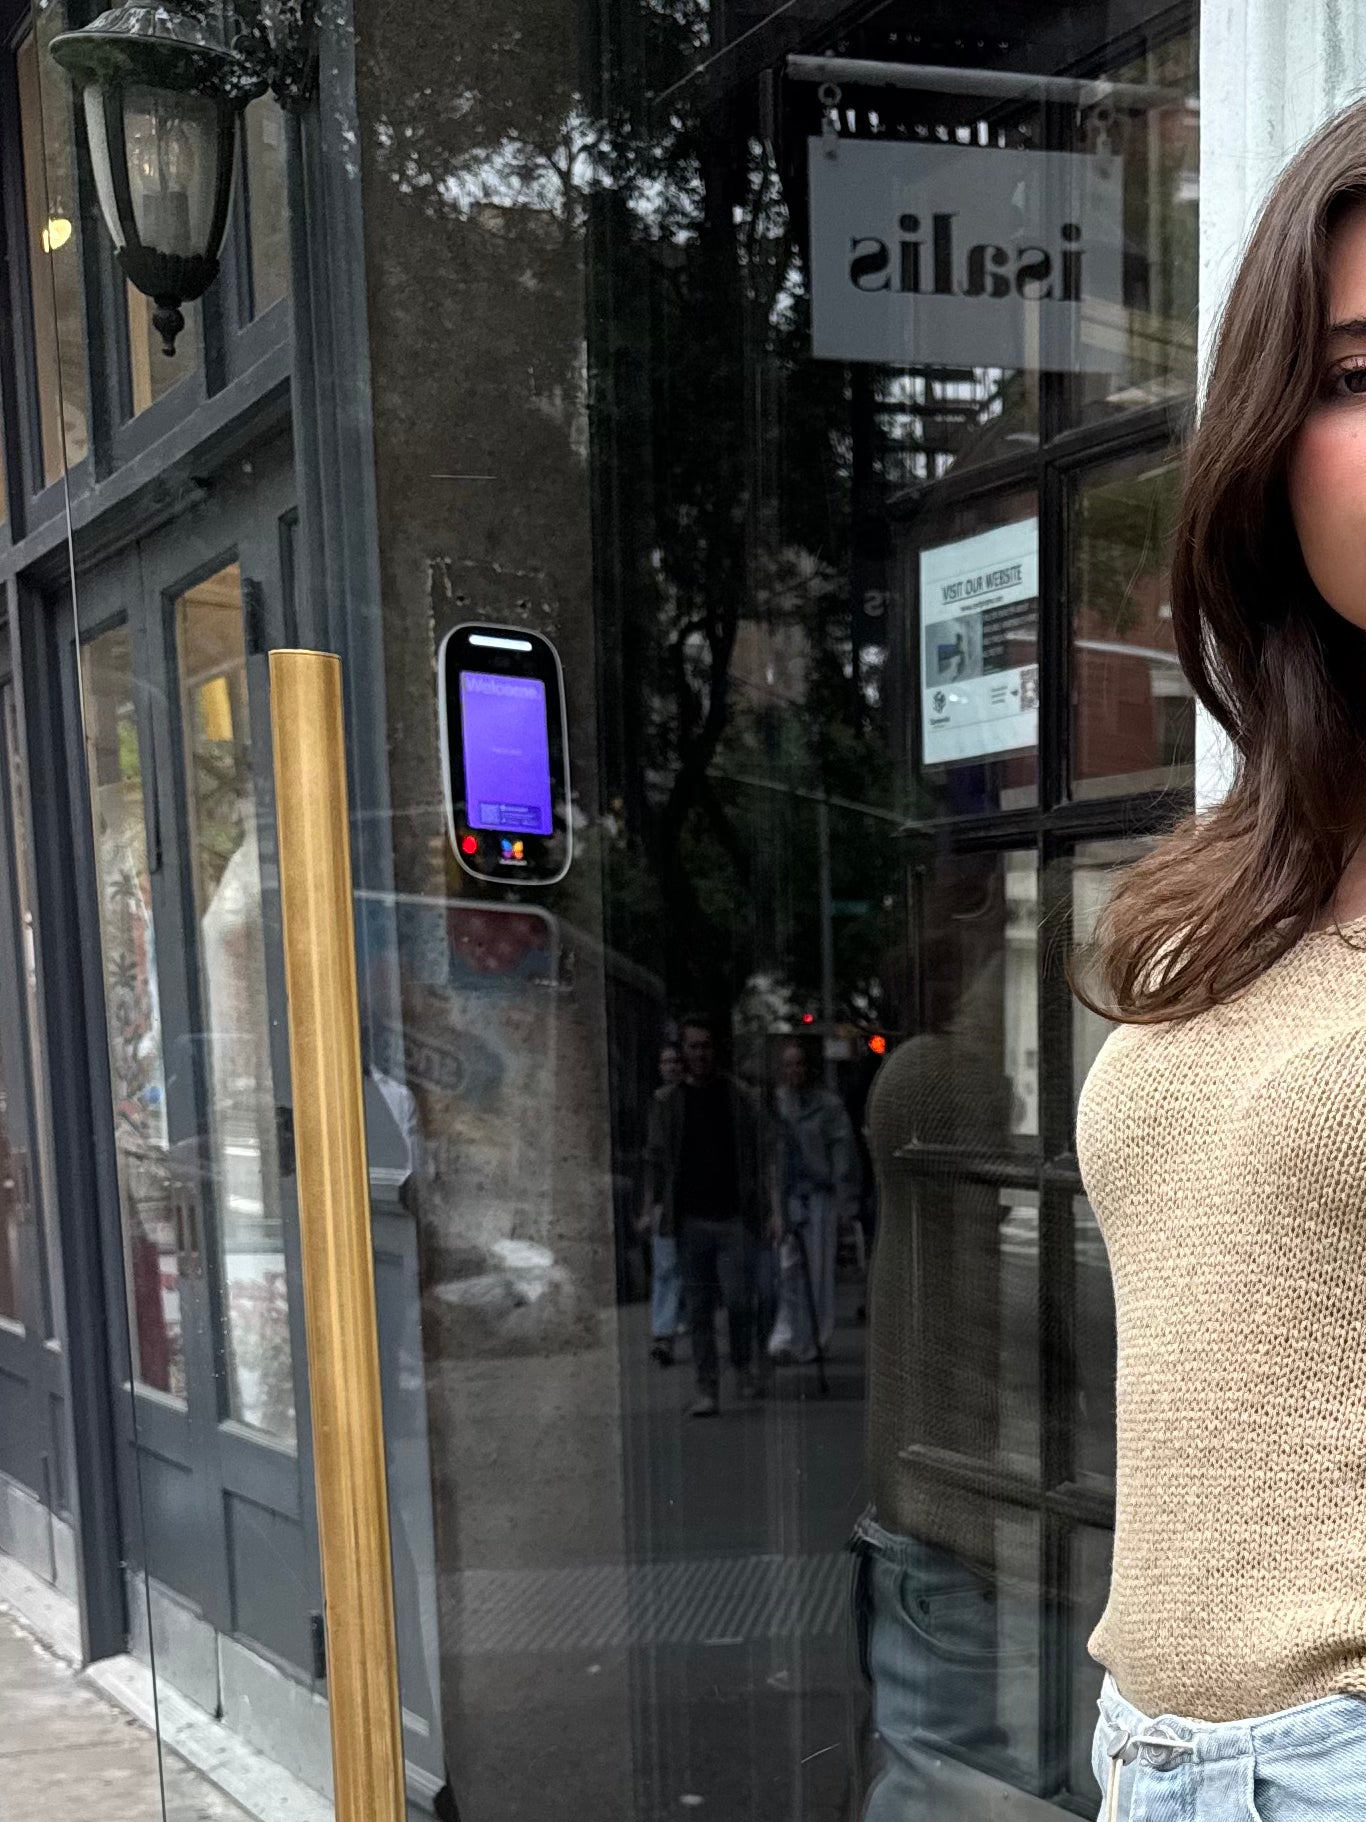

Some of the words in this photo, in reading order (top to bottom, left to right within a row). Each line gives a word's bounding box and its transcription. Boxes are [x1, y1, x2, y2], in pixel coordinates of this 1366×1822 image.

[942, 581, 963, 600] VISIT
[965, 576, 983, 595] OUR
[986, 564, 1022, 589] WEBSITE
